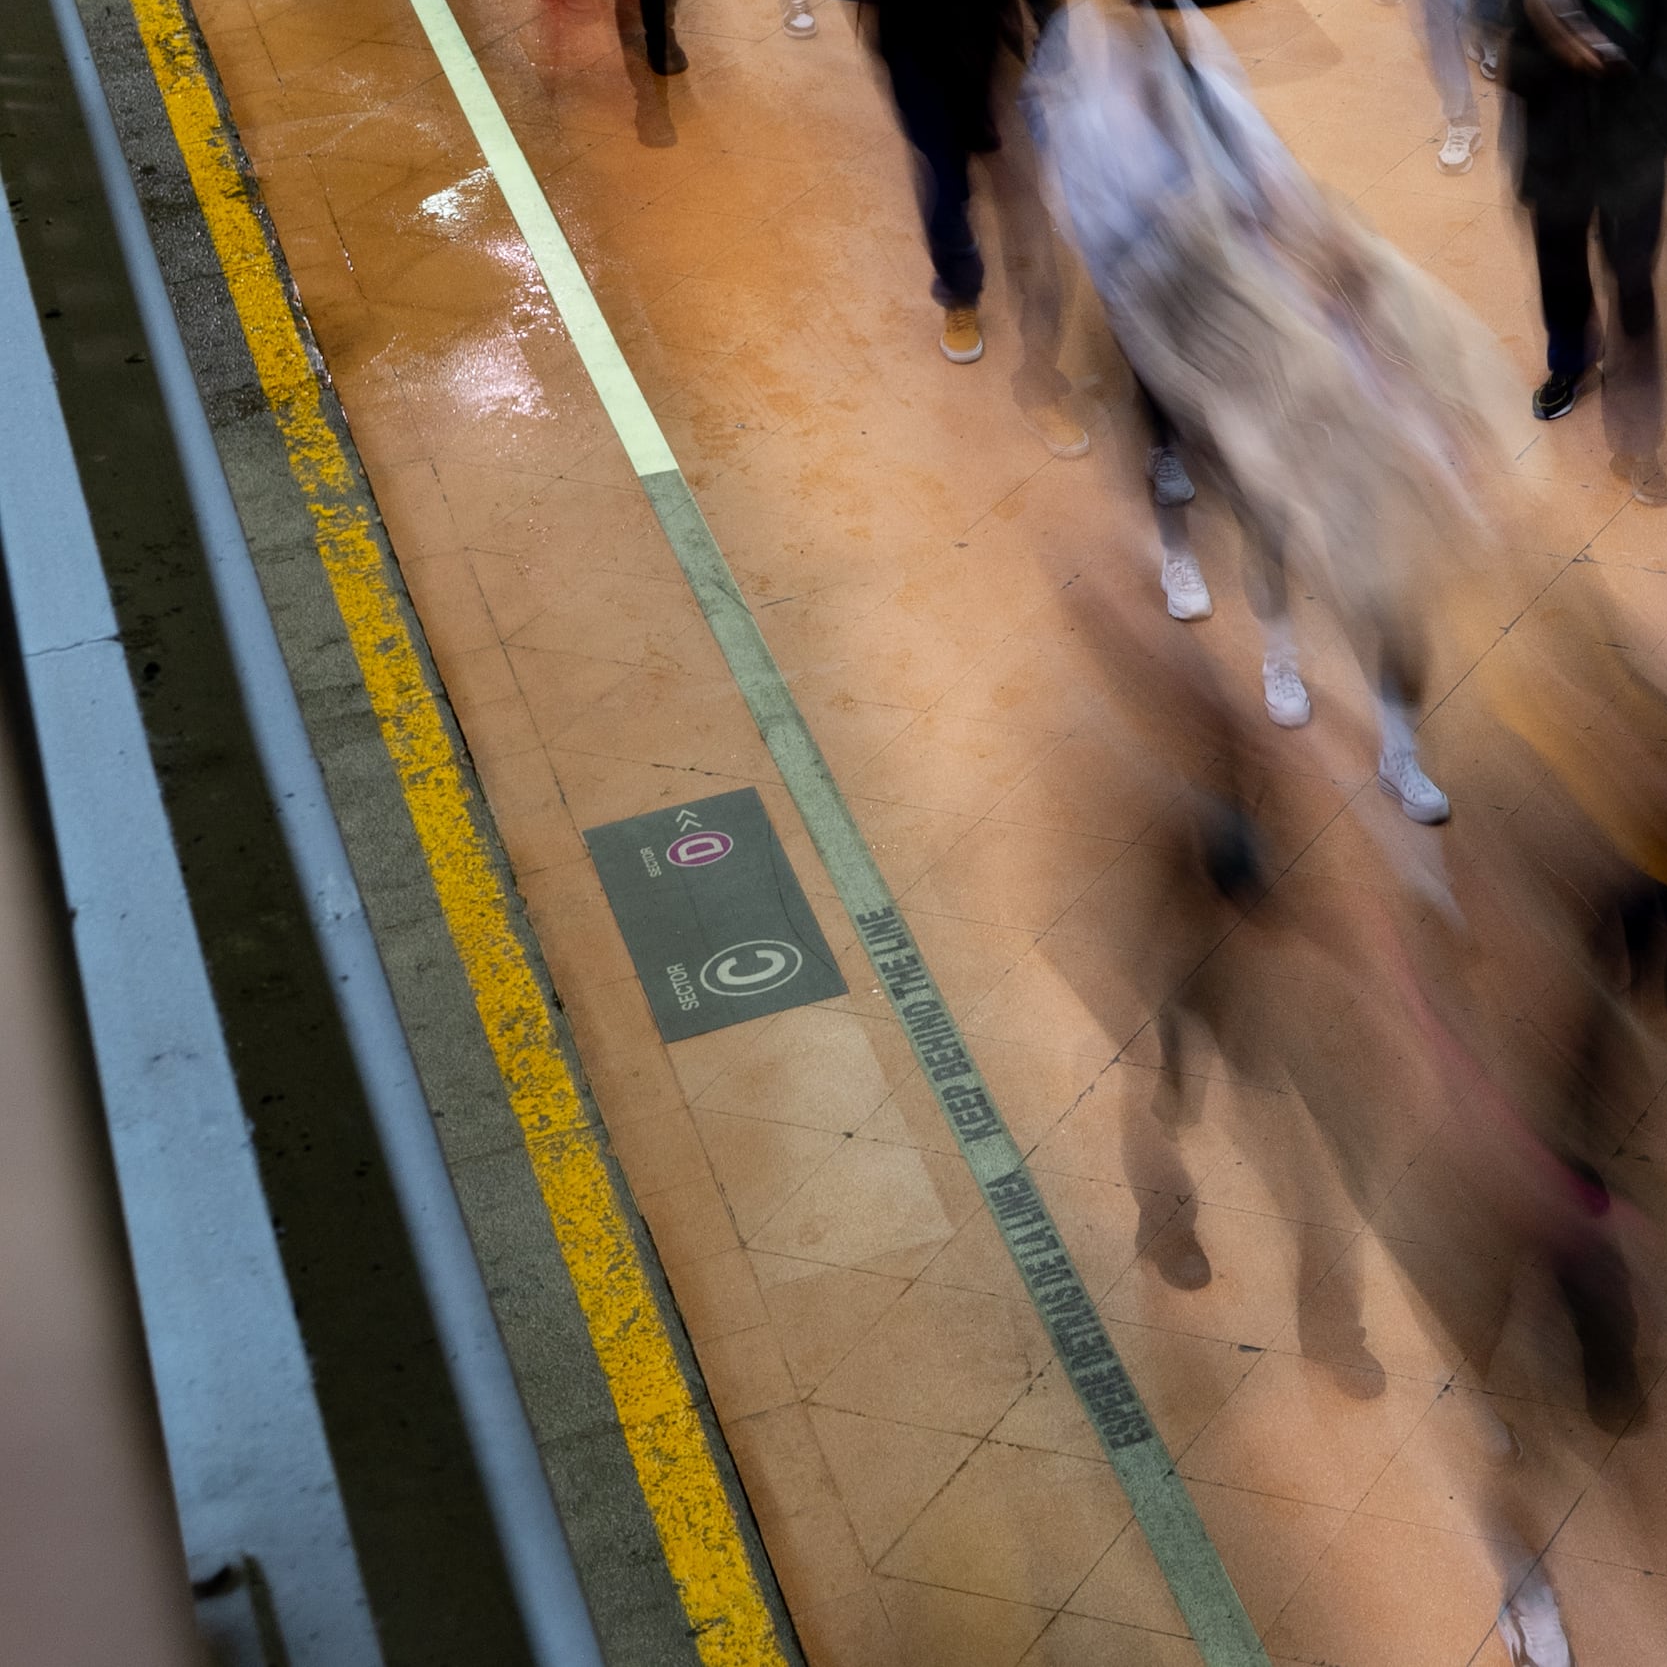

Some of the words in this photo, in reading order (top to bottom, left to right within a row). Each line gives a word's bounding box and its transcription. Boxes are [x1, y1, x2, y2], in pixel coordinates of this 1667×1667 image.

[639, 846, 663, 878] SECTOR
[677, 837, 725, 863] D
[856, 906, 910, 957] LINE
[666, 962, 700, 1012] SECTOR
[716, 949, 787, 985] C
[879, 954, 931, 1001] THE
[902, 1000, 973, 1082] BEHIND
[941, 1084, 1003, 1144] KEEP
[986, 1169, 1046, 1231] LINEA
[1012, 1225, 1060, 1259] LA
[1025, 1254, 1073, 1289] DE
